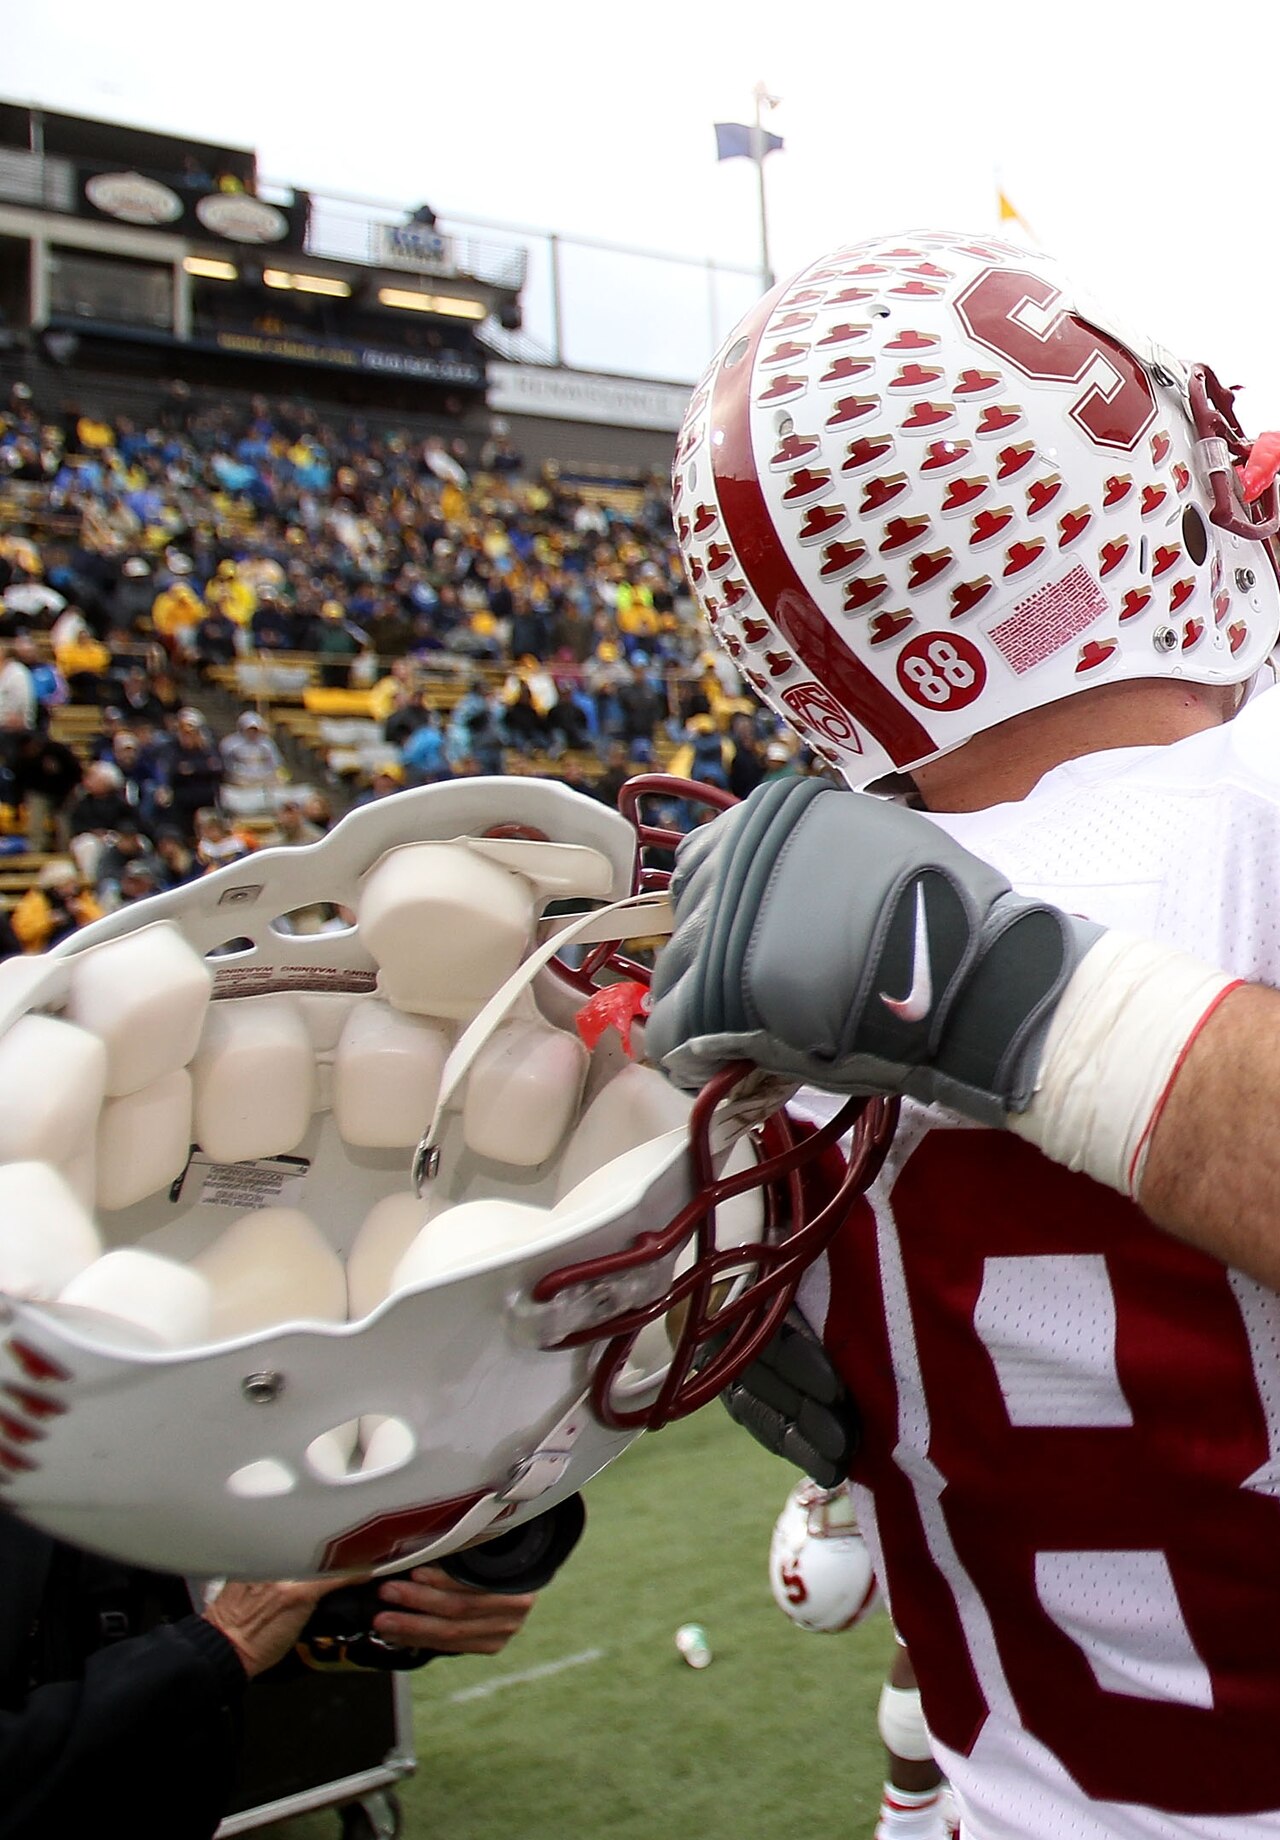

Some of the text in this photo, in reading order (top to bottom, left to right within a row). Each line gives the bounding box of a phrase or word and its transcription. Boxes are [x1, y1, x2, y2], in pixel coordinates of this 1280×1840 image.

[953, 267, 1159, 453] S
[1013, 582, 1052, 612] WARNING
[903, 640, 976, 704] 88
[216, 966, 274, 975] WARNING
[280, 966, 337, 974] WARNING
